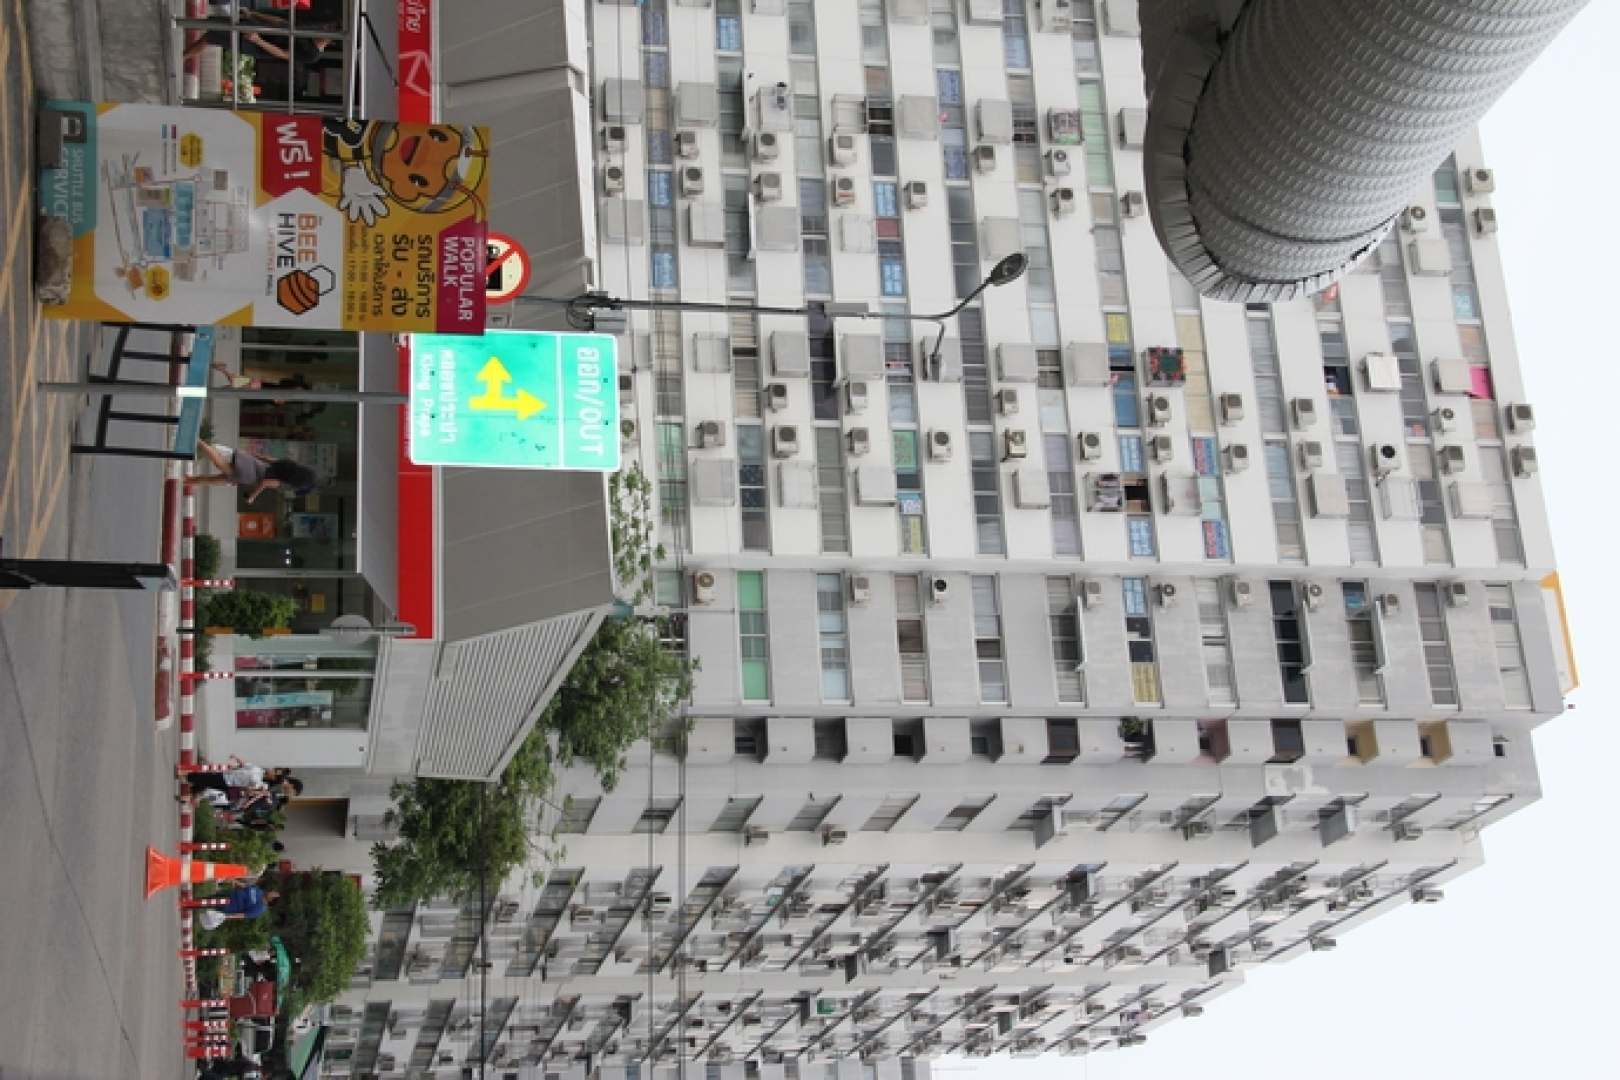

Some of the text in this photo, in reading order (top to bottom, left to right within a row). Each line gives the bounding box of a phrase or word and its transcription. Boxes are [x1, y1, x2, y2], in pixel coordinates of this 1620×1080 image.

[72, 148, 84, 224] SHUTTLE BUS
[277, 213, 296, 268] HIVE
[298, 213, 318, 264] BEE
[392, 234, 414, 261] รับ
[443, 236, 458, 287] WALK
[392, 287, 414, 316] ส่ง
[458, 236, 475, 321] POPULAR
[416, 354, 435, 438] Klong Prapa
